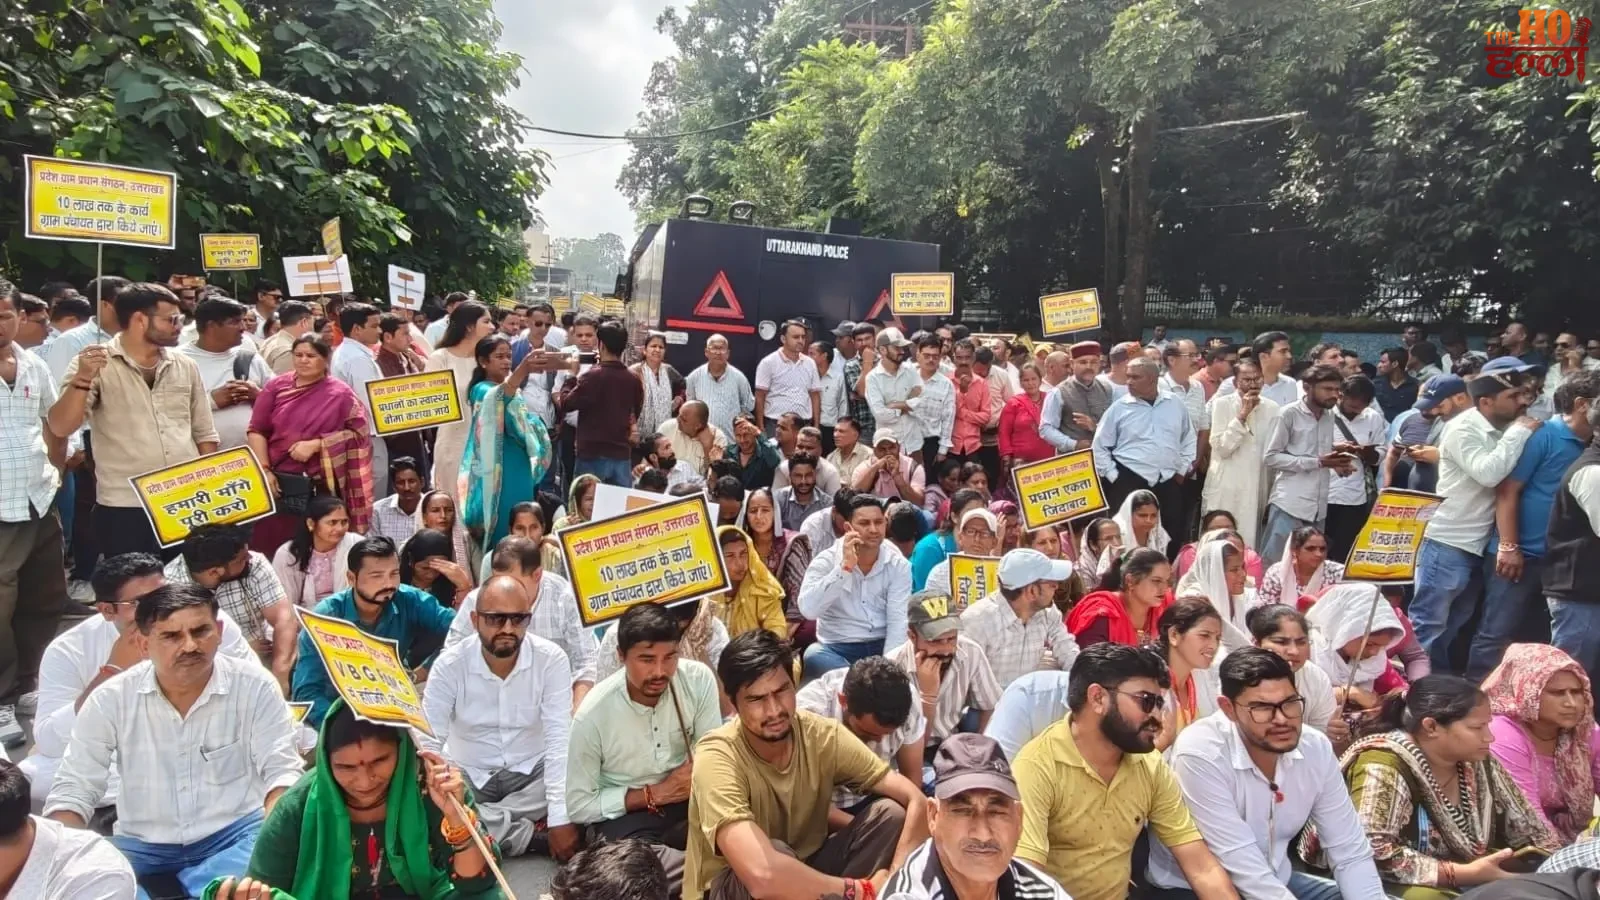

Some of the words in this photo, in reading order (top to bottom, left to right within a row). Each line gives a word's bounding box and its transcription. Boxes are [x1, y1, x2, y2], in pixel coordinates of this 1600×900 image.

[39, 170, 58, 183] प्रदेश
[60, 174, 75, 184] ग्राम
[78, 176, 98, 187] प्रधान
[57, 196, 70, 209] 10
[73, 199, 93, 212] लाख
[97, 201, 114, 212] तक
[117, 200, 126, 215] के
[129, 202, 150, 216] कार्य
[40, 214, 60, 228] ग्राम
[63, 213, 93, 228] पंचायत
[96, 219, 114, 232] द्वारा
[766, 238, 822, 257] UTTARAKHAND
[823, 244, 849, 260] POLICE
[378, 398, 405, 412] प्रधानों
[406, 398, 417, 407] का
[384, 413, 405, 425] बीमा
[406, 410, 432, 421] कराया
[146, 482, 163, 495] प्रदेश
[163, 479, 177, 490] ग्राम
[177, 475, 195, 487] प्रधान
[1028, 487, 1061, 504] प्रधान
[1063, 478, 1092, 496] एकता
[162, 490, 211, 516] हमारी
[180, 509, 210, 530] पूरी
[212, 498, 248, 517] करो
[1042, 496, 1088, 518] जिंदाबाद
[573, 538, 594, 556] प्रदेश
[593, 535, 610, 551] ग्राम
[611, 531, 634, 549] प्रधान
[634, 522, 664, 540] संगठन,
[663, 510, 700, 531] उत्तराखंड
[600, 565, 614, 584] 10
[616, 561, 639, 580] लाख
[639, 556, 658, 572] तक
[659, 550, 670, 567] के
[672, 540, 694, 562] कार्य
[589, 593, 611, 615] ग्राम
[611, 583, 645, 604] पंचायत
[645, 577, 666, 597] द्वारा
[664, 567, 687, 589] किये
[688, 560, 714, 583] जाएं।
[974, 564, 986, 601] प्रधान
[921, 596, 948, 619] W
[334, 660, 346, 677] V
[347, 663, 361, 680] B
[362, 665, 377, 682] G
